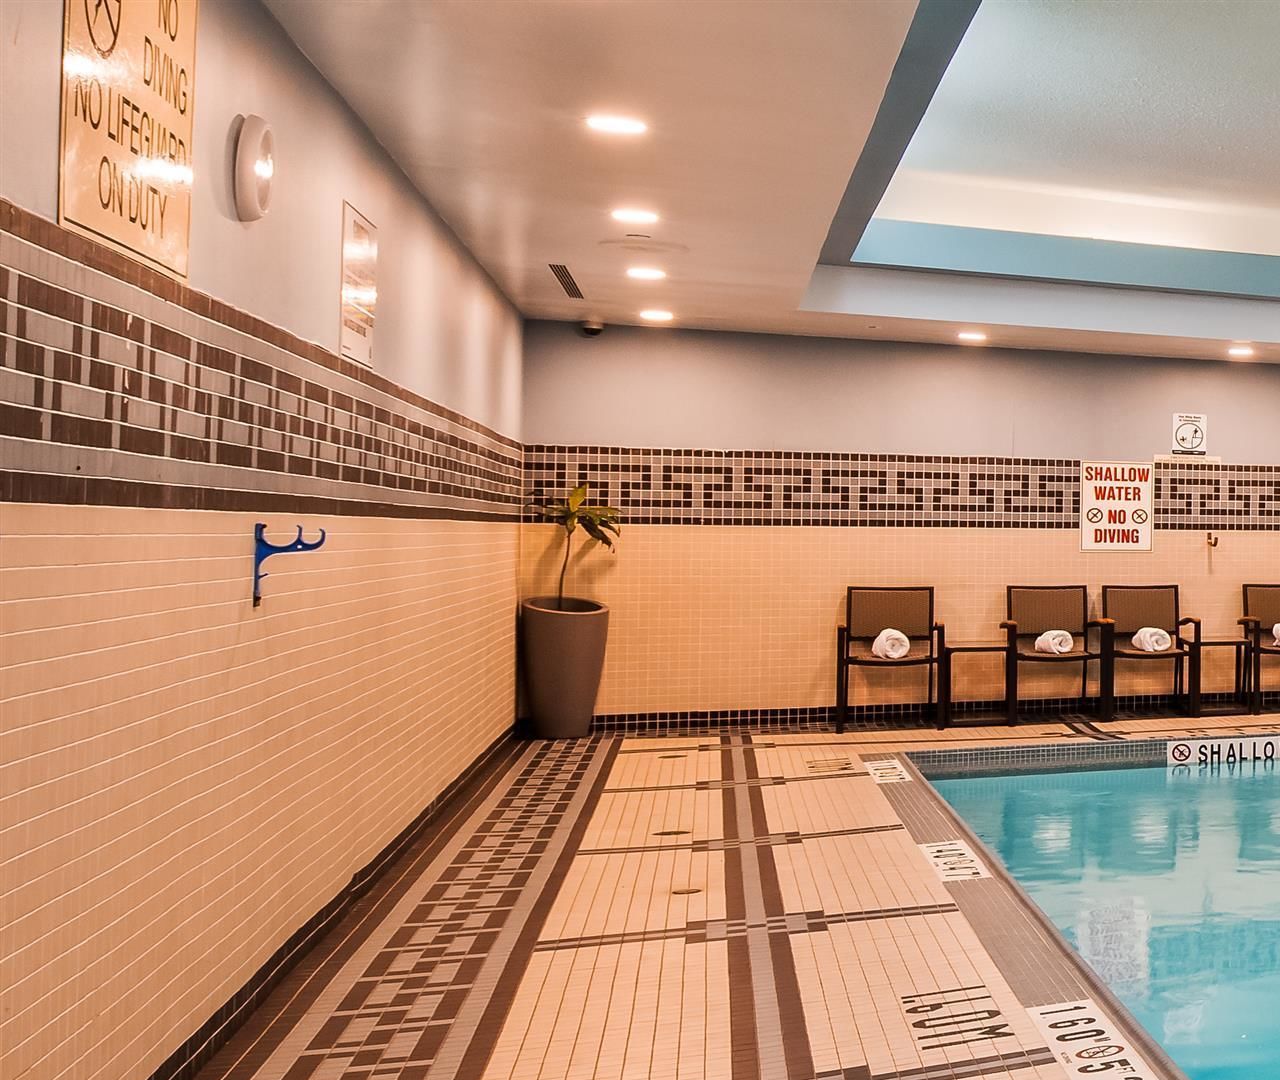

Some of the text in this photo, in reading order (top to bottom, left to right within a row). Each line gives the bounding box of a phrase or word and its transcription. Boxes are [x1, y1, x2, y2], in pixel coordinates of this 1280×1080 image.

[158, 0, 178, 41] NO
[144, 35, 188, 115] DIVING
[75, 78, 102, 130] NO
[98, 156, 168, 239] ON DUTY
[1085, 466, 1150, 482] SHALLOW
[1094, 486, 1141, 501] WATER
[1108, 509, 1126, 524] NO
[1094, 528, 1140, 543] DIVING
